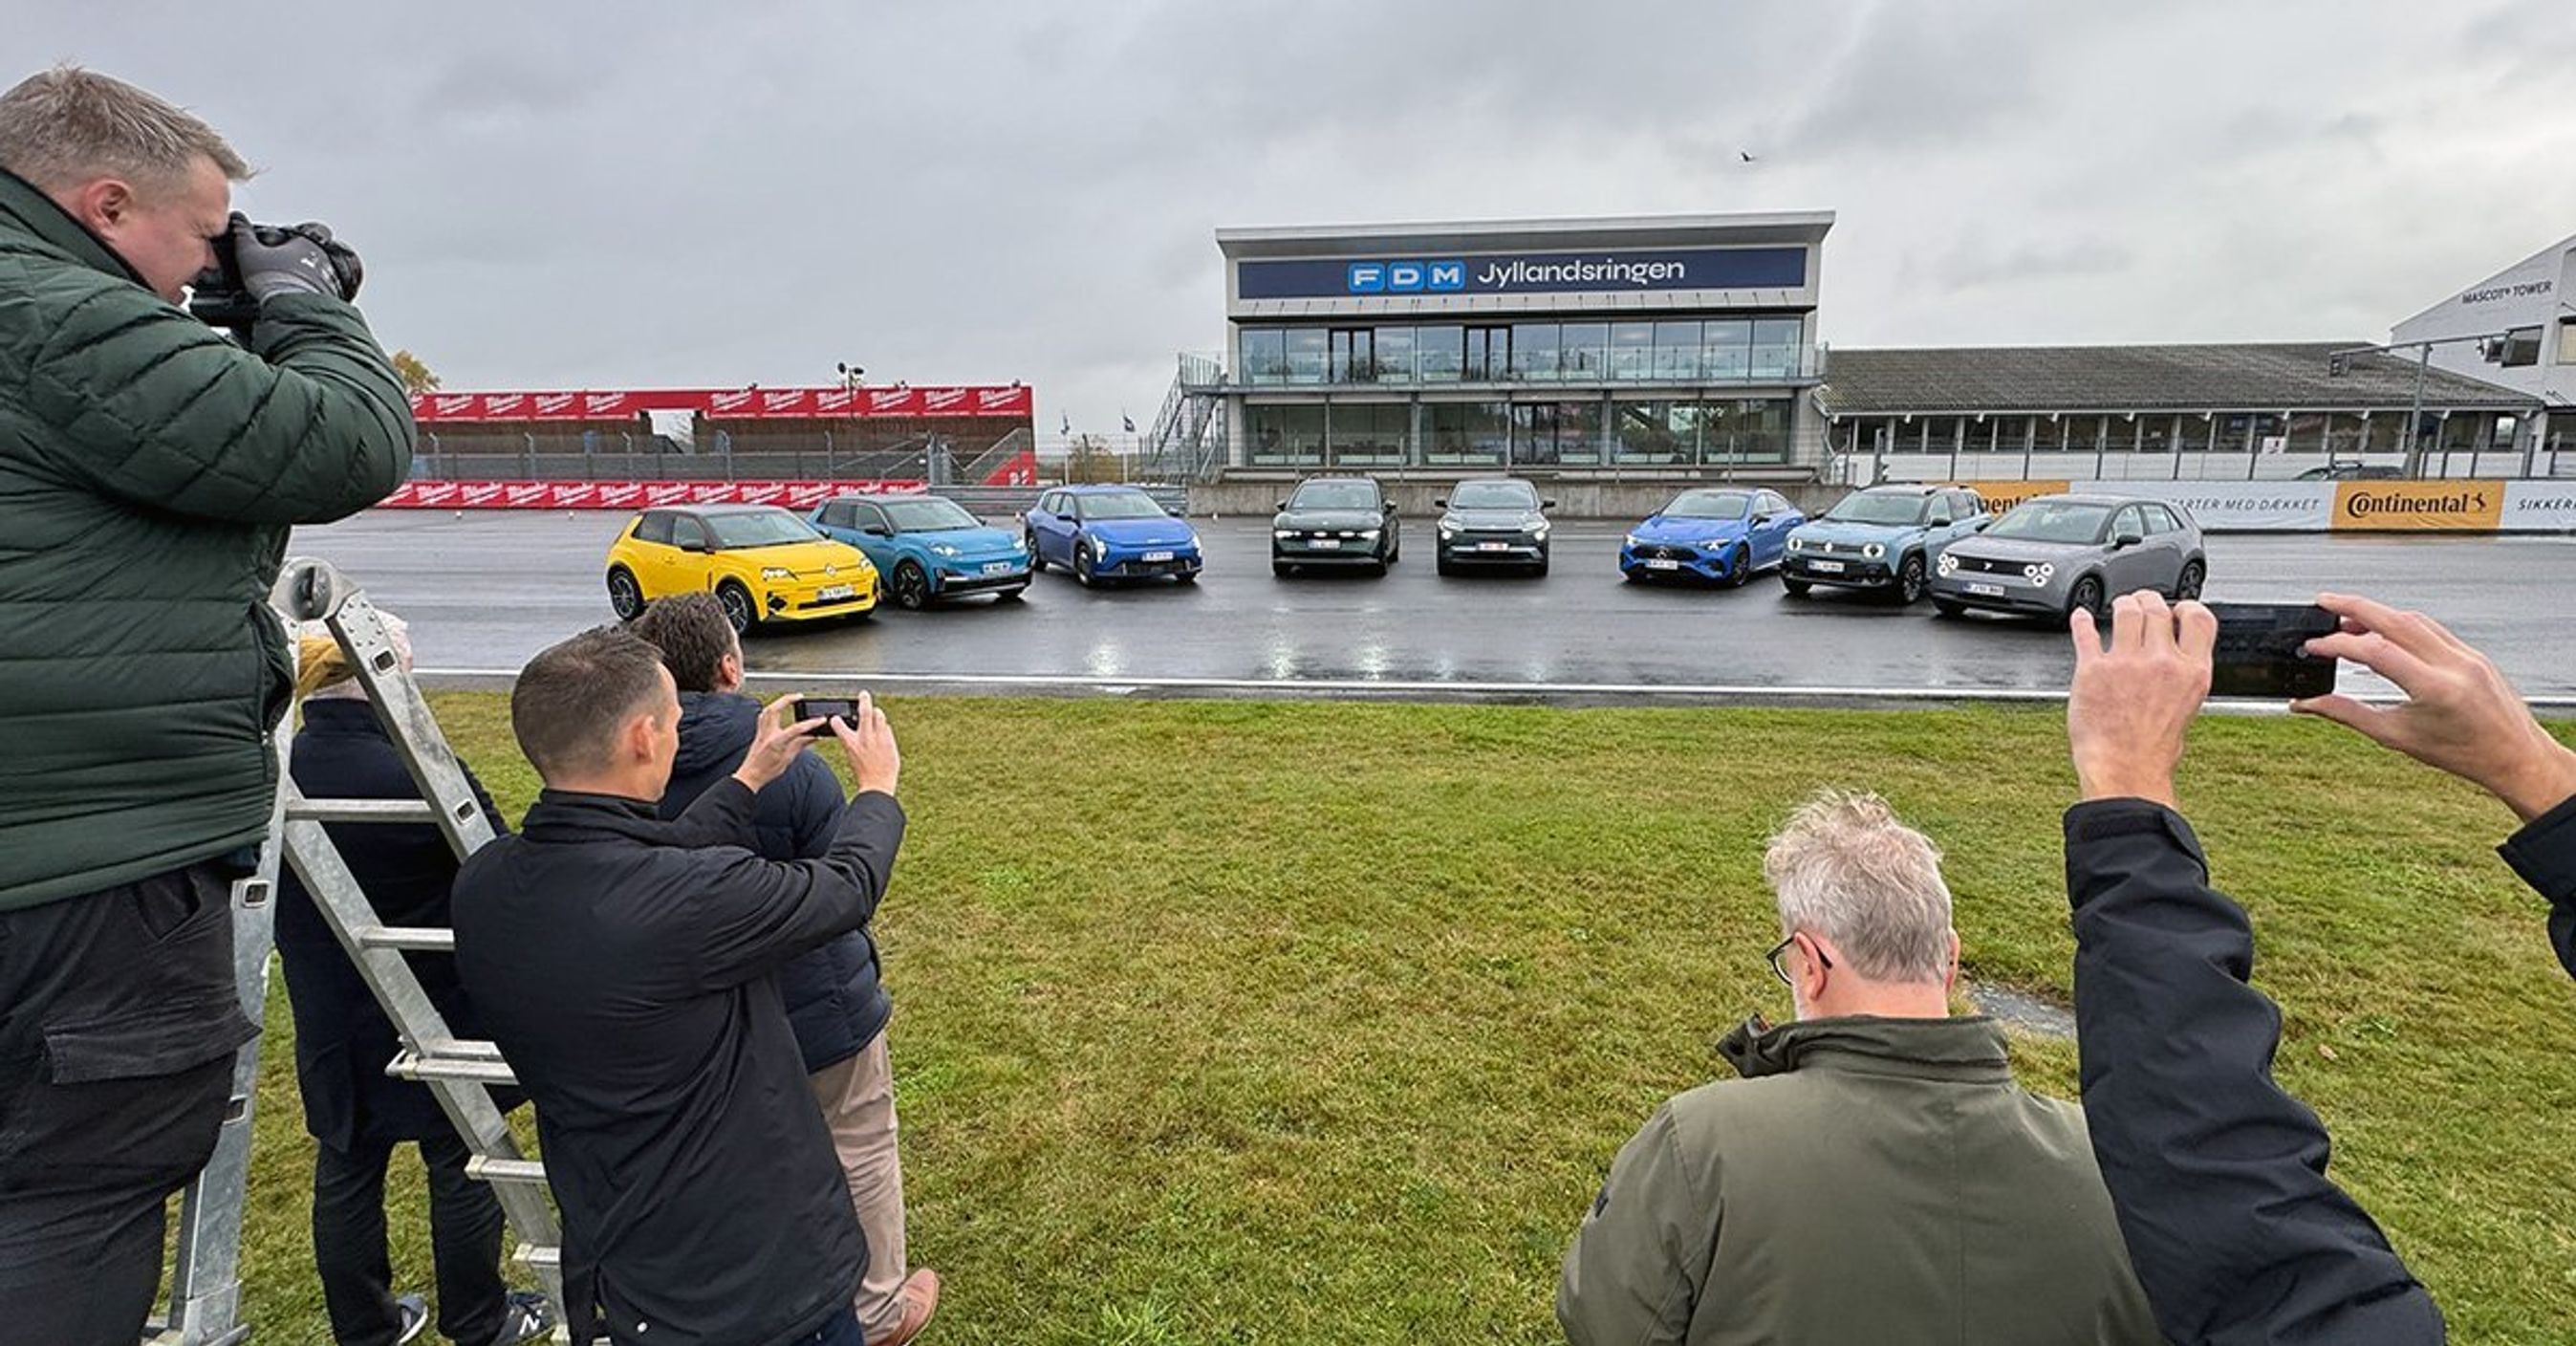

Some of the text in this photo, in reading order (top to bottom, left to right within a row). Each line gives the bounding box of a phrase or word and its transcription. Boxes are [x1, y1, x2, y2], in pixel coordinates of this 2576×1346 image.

[1353, 258, 1686, 288] FDM Jyllandsringen
[2513, 280, 2552, 296] TOWER
[2348, 491, 2469, 518] Continental
